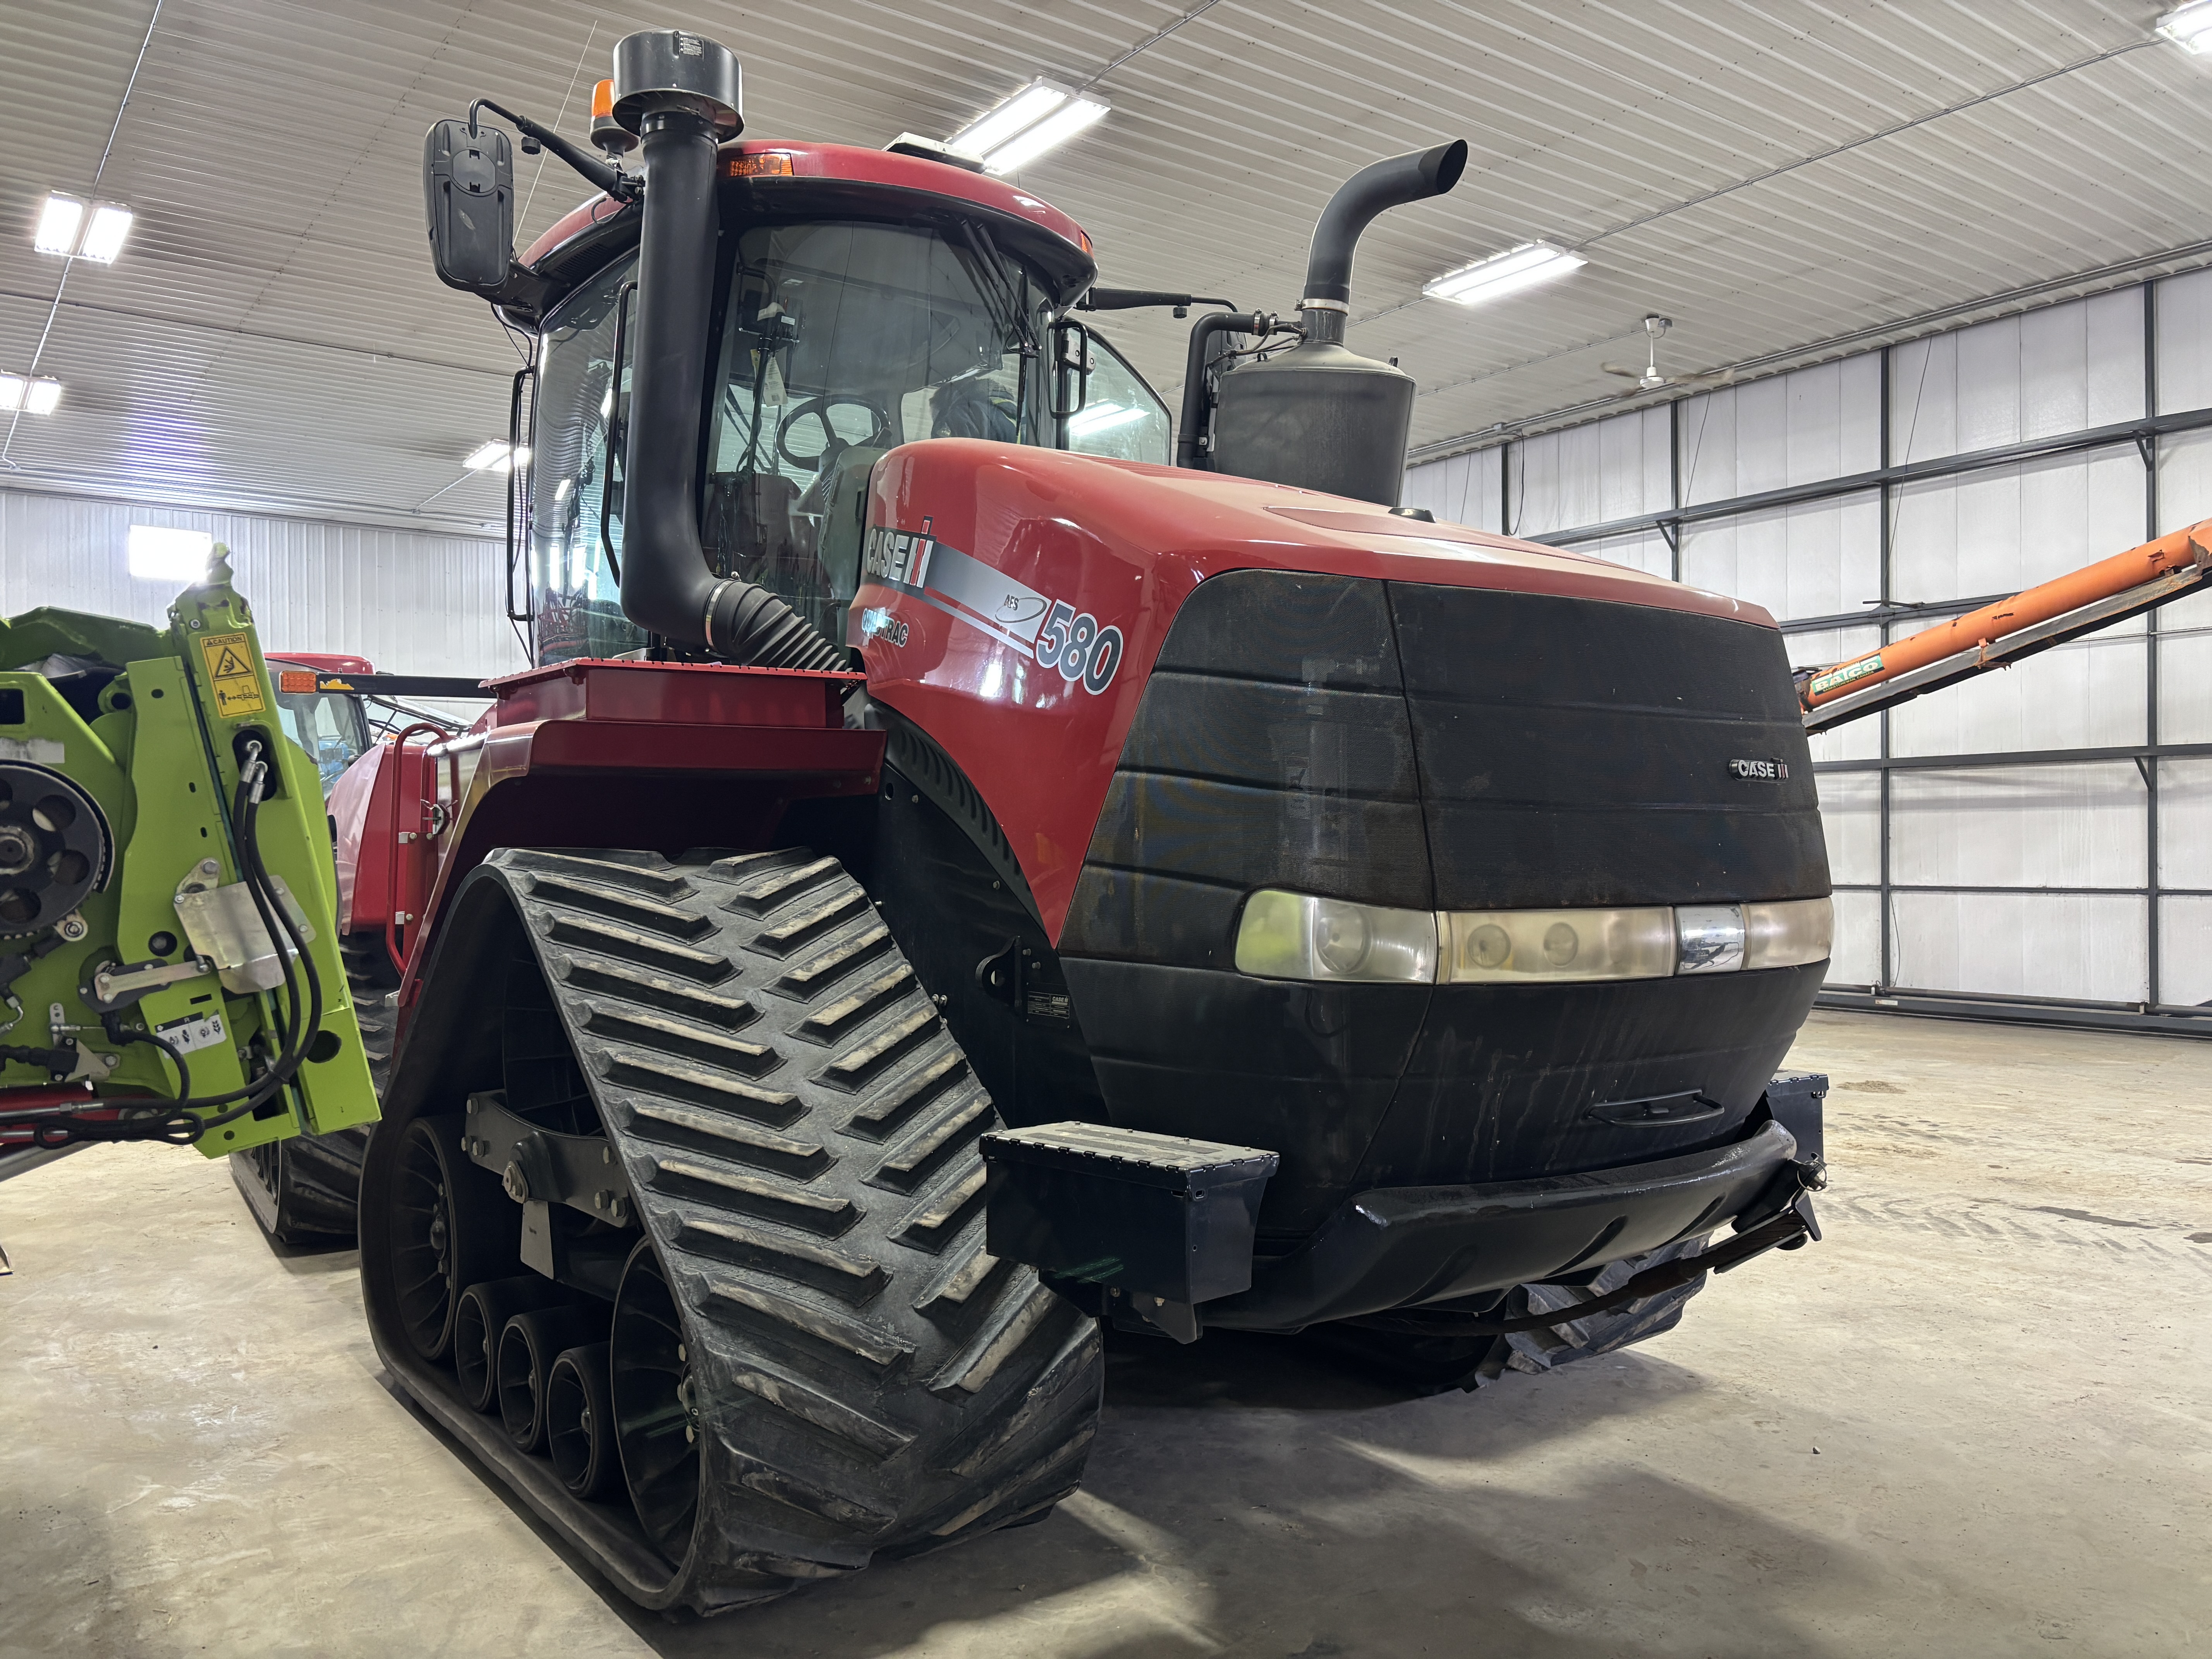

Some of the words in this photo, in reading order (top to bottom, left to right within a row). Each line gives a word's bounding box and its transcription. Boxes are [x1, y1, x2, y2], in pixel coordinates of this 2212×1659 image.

[867, 528, 910, 581] CASE
[1004, 594, 1019, 611] AFS
[213, 636, 242, 644] CAUTION
[1036, 599, 1123, 695] 580
[1815, 662, 1879, 691] BATCO
[1856, 670, 1875, 679] CANADA
[1738, 759, 1775, 778] CASE
